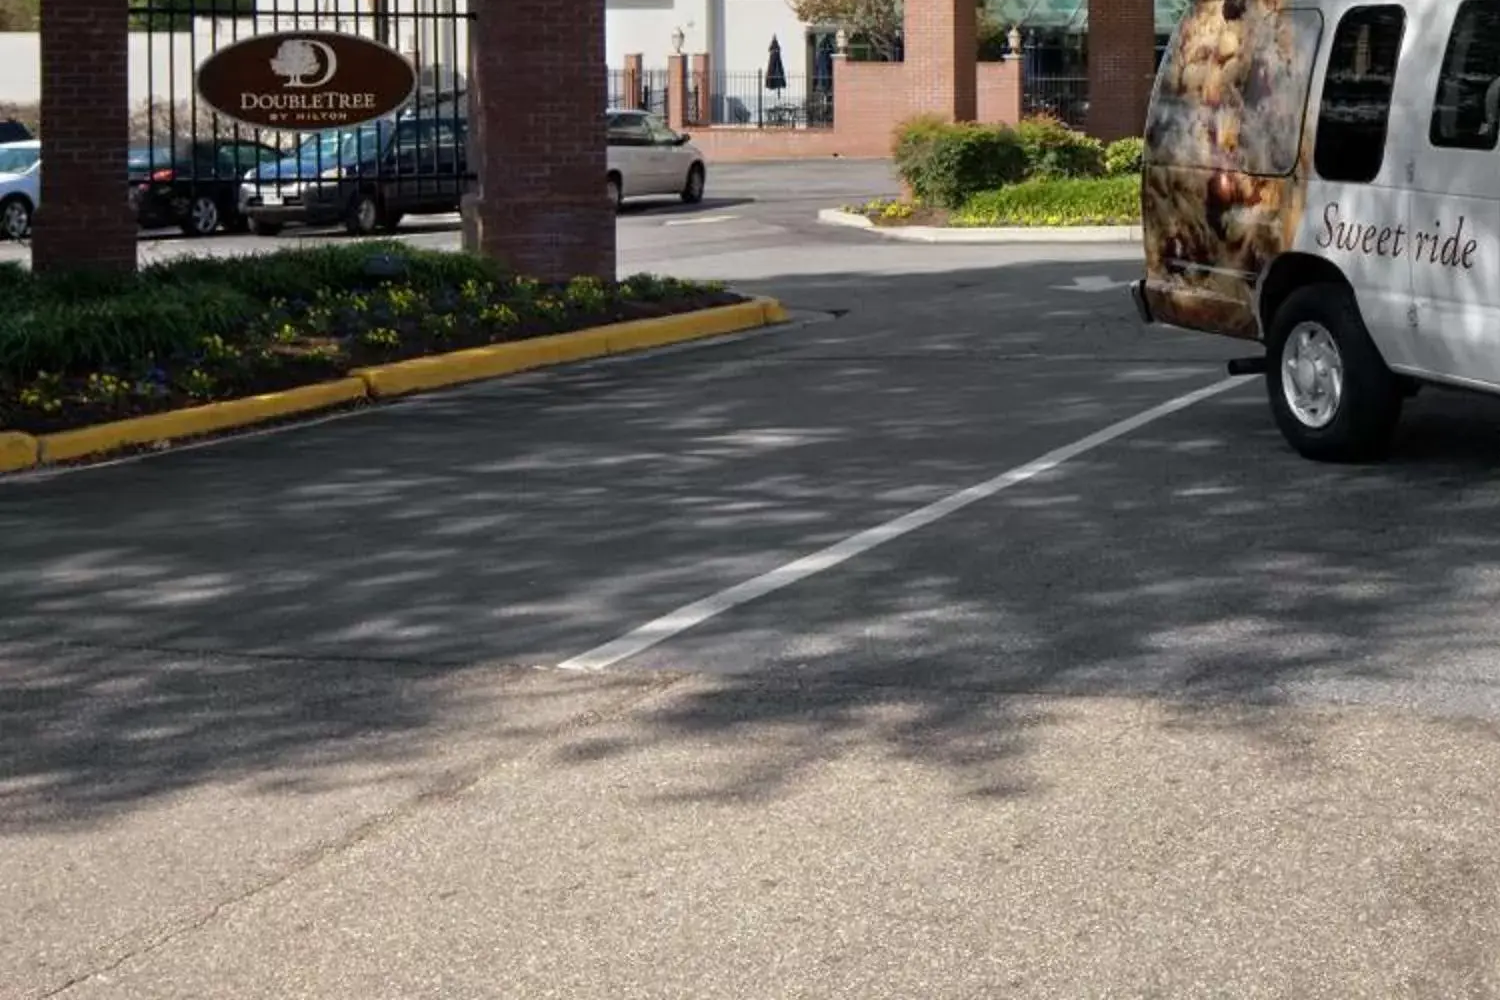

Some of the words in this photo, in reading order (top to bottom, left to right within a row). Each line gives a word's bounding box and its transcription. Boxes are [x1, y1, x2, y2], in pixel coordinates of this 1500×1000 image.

[241, 92, 376, 110] DOUBLETREE
[269, 112, 289, 121] BY
[296, 112, 348, 121] HILTON
[1316, 201, 1405, 257] Sweet
[1415, 215, 1478, 269] ride
